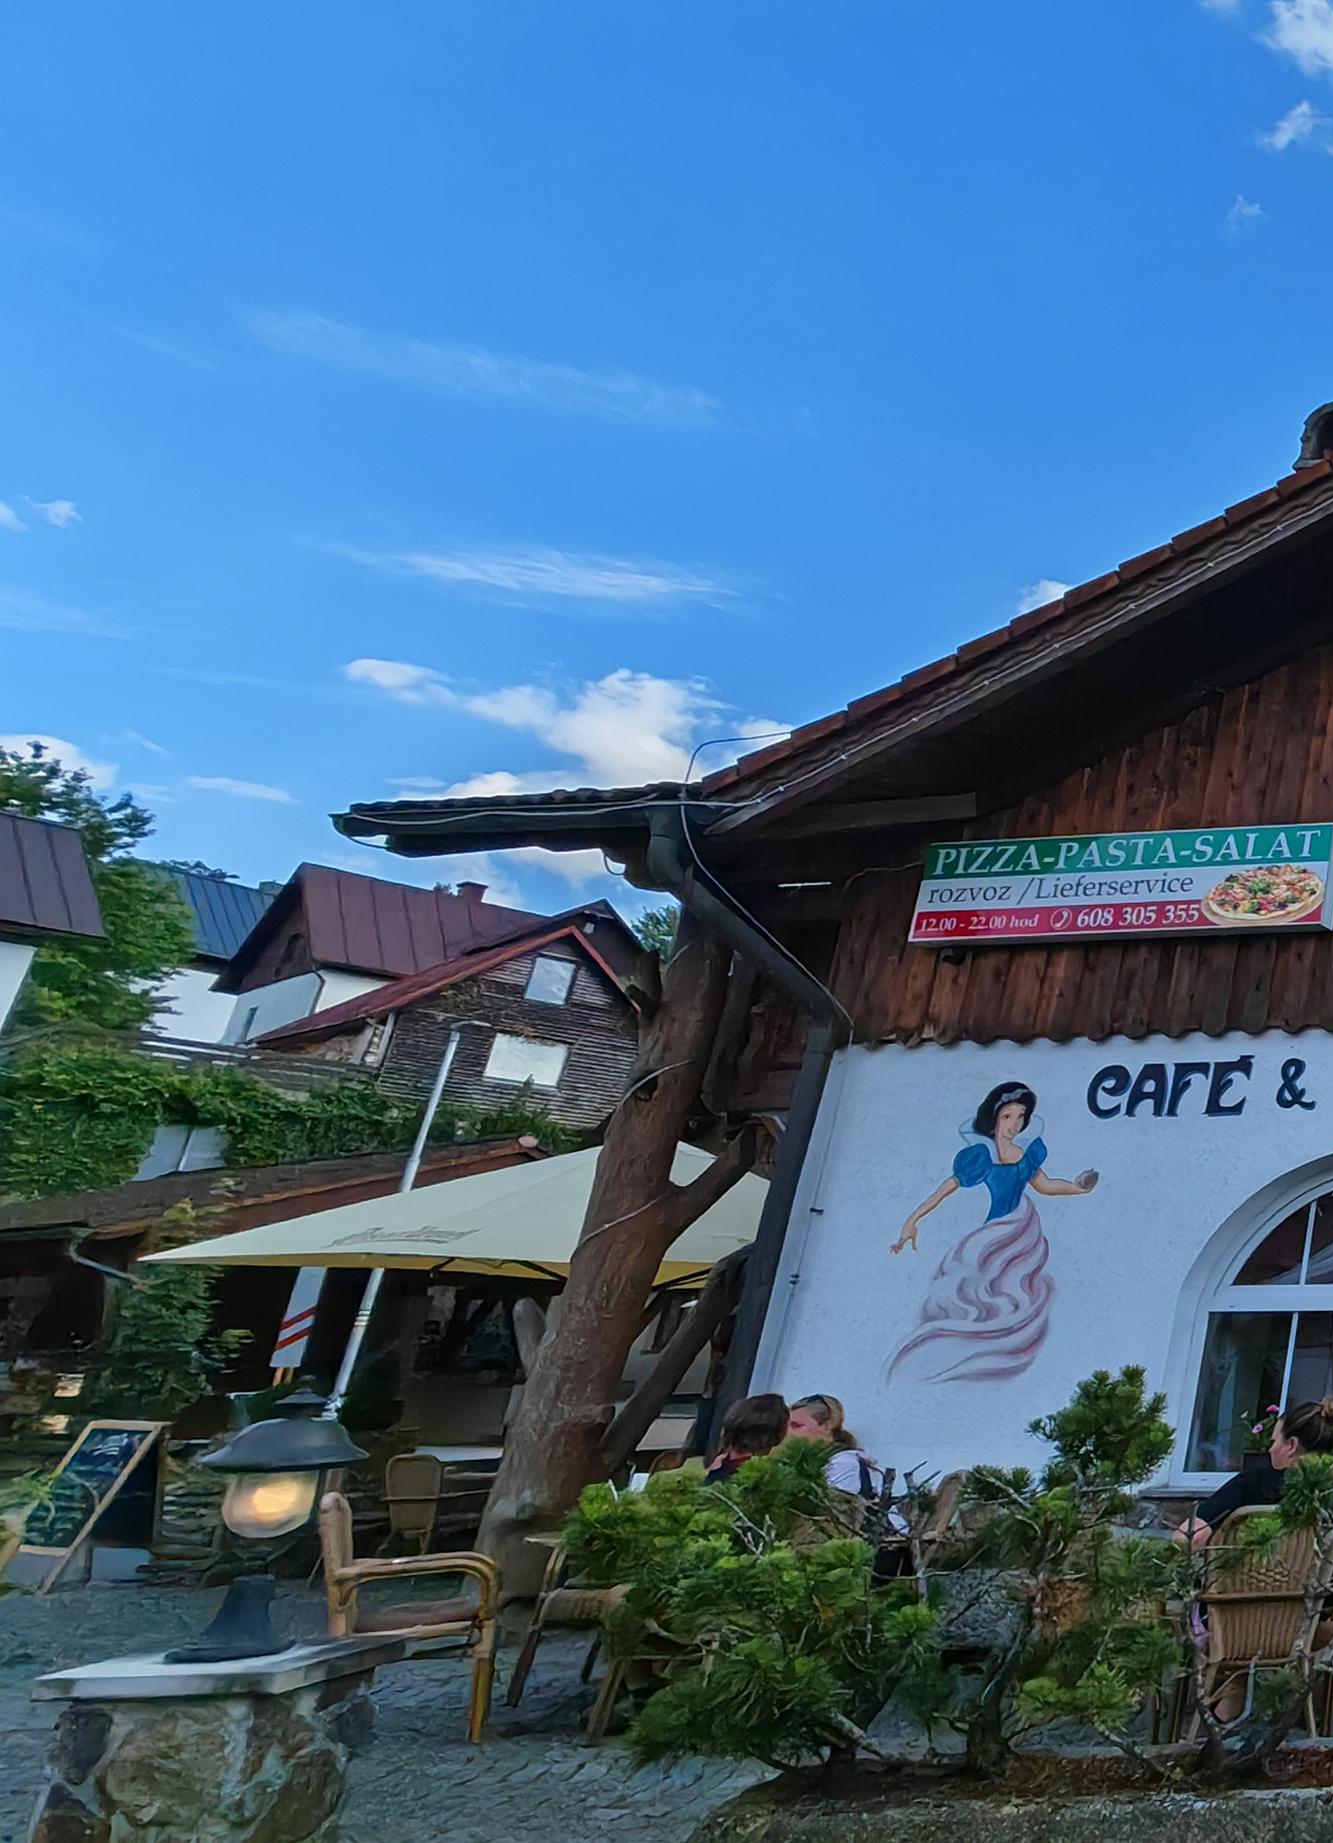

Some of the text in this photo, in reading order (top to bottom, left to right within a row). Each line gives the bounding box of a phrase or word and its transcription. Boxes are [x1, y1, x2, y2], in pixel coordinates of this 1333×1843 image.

[934, 829, 1321, 877] PIZZA-PASTA-SALAT
[927, 883, 1013, 904] rozvoz
[968, 915, 1007, 930] 22.00
[1009, 913, 1040, 928] hod
[1076, 904, 1200, 928] 608 305 355
[1086, 1054, 1255, 1119] CAFÉ
[1276, 1057, 1317, 1111] &
